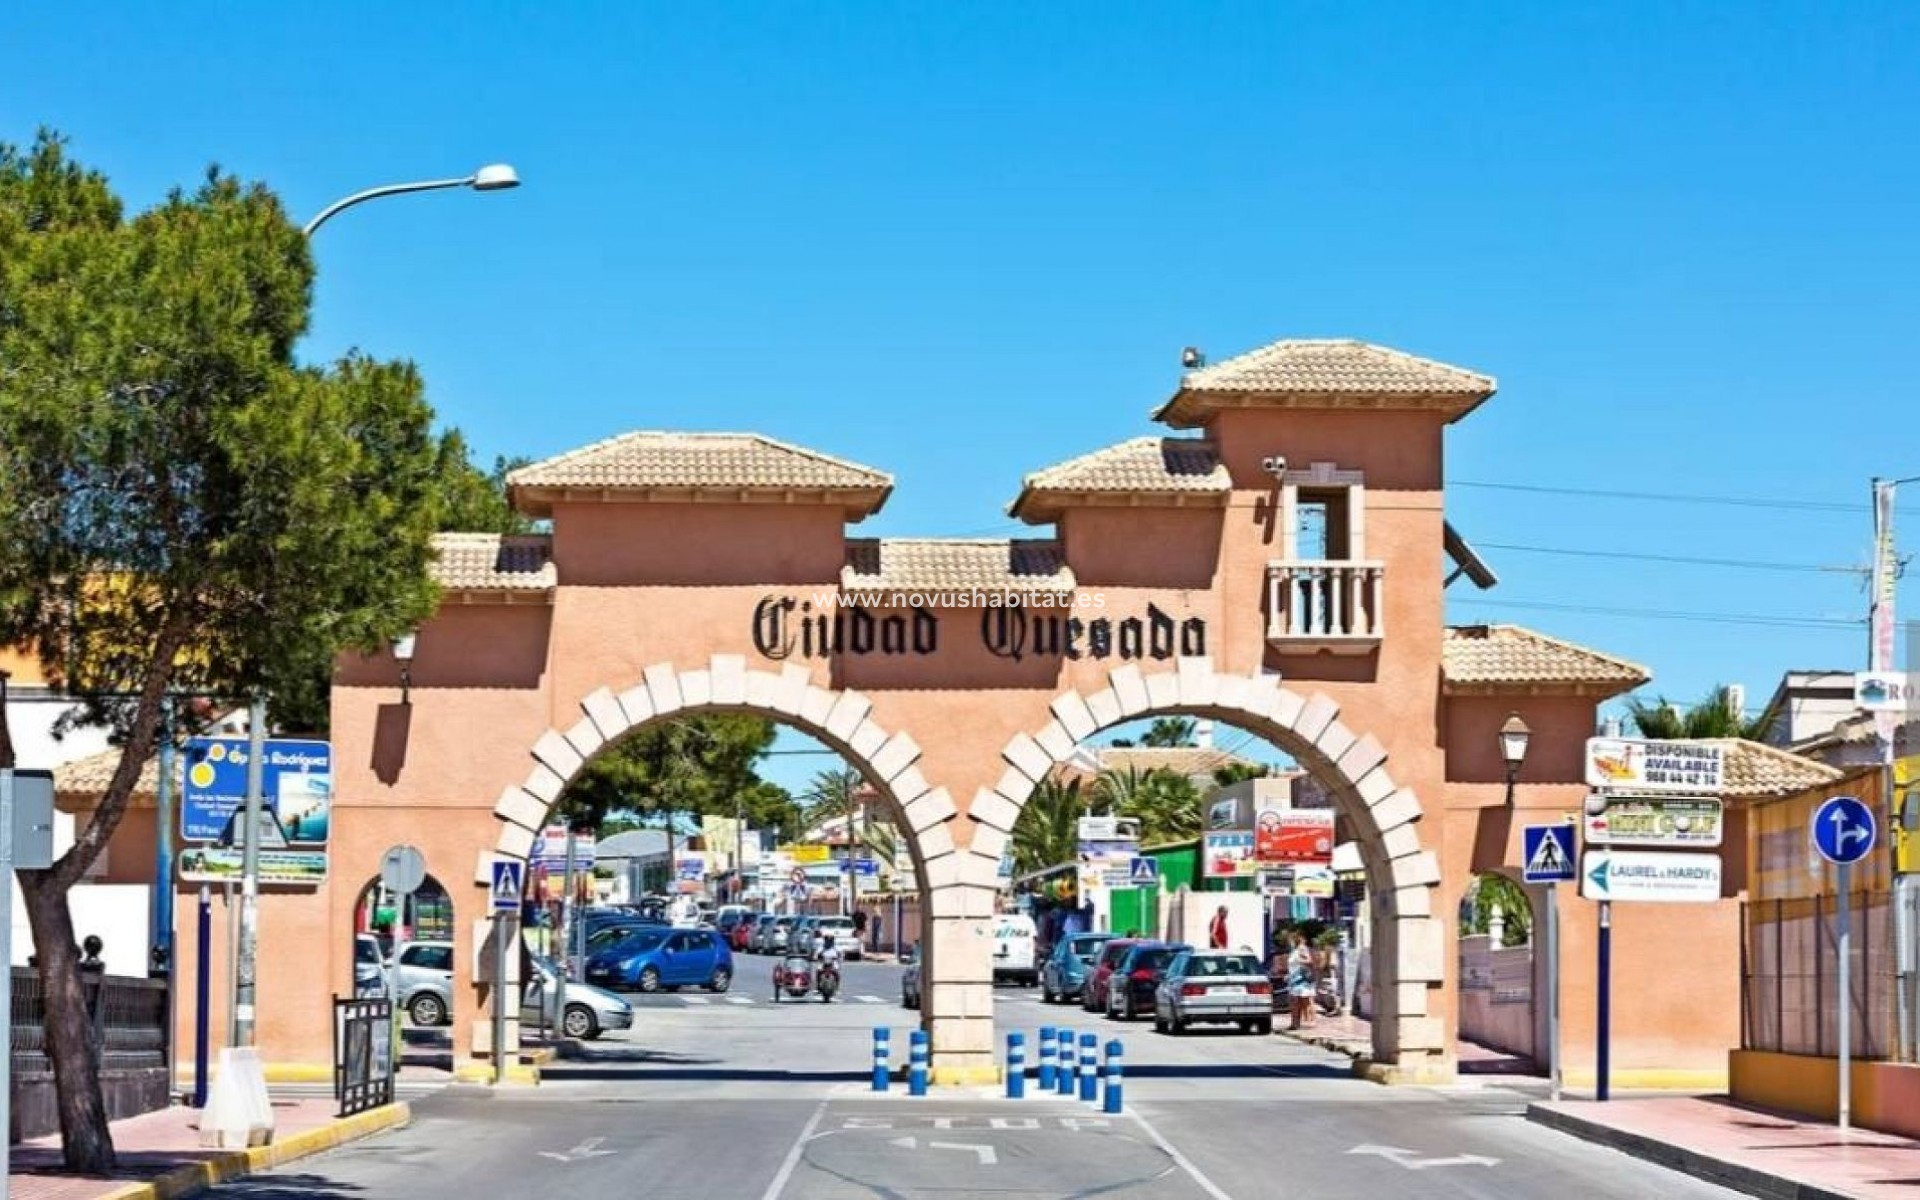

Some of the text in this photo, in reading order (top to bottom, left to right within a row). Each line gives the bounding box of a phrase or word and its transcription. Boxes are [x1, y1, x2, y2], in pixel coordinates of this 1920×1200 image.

[752, 593, 1207, 662] Ciudad Quesada
[1645, 744, 1719, 760] DISPONIBLE
[1645, 758, 1719, 773] AVAILABLE
[1610, 866, 1659, 878] LAUREL
